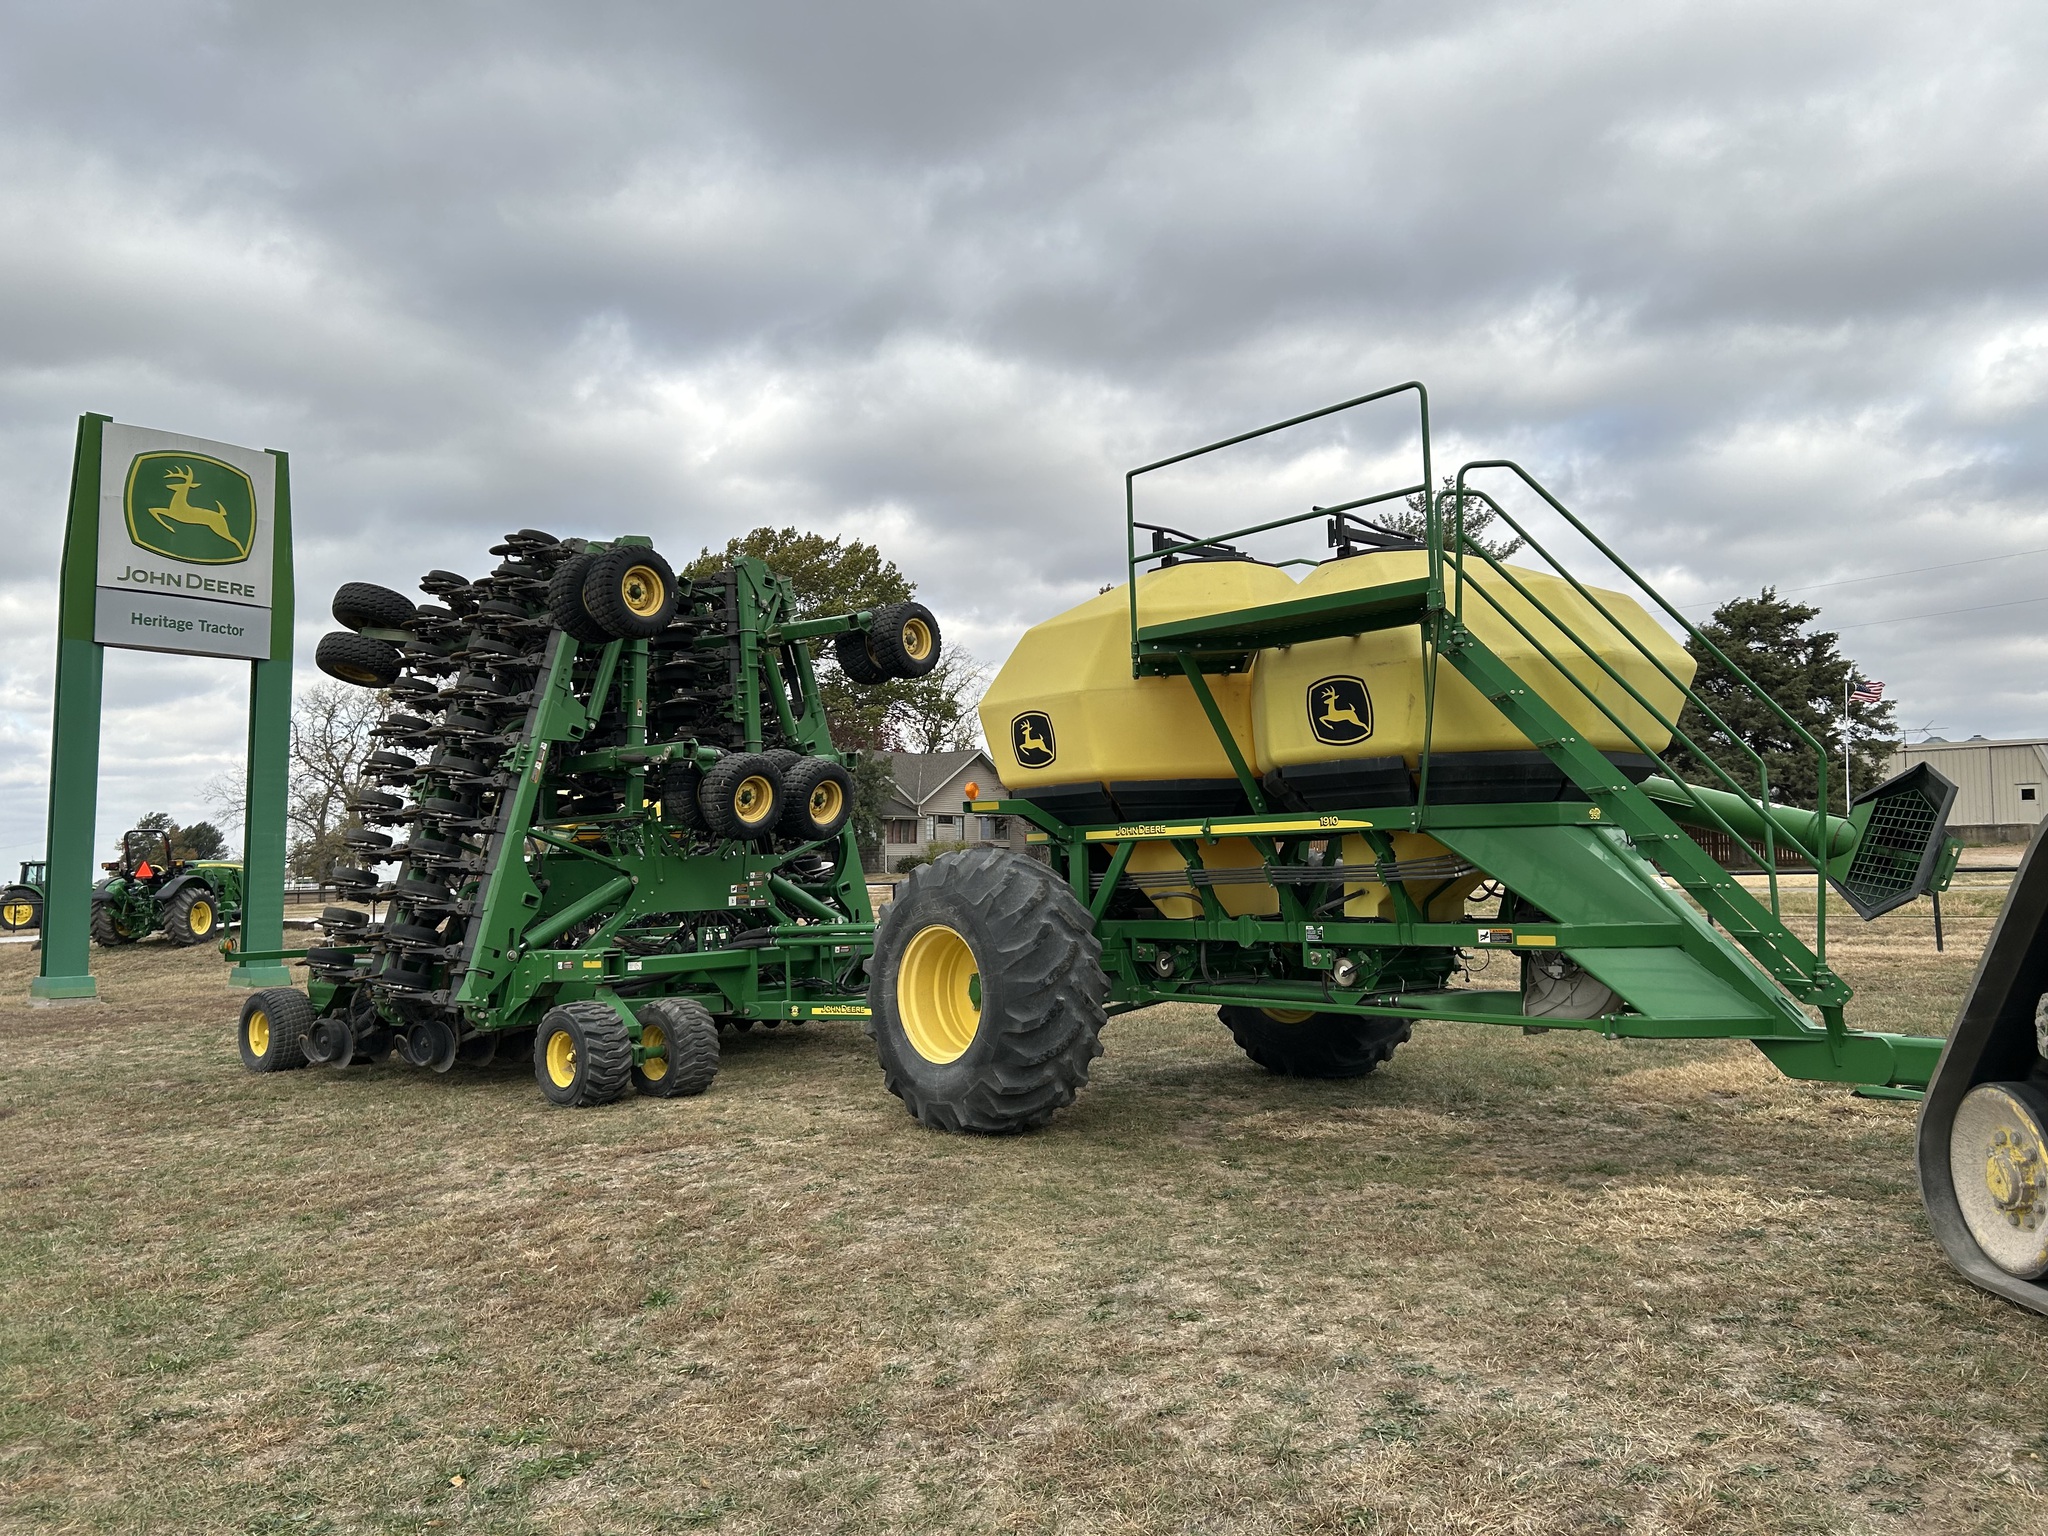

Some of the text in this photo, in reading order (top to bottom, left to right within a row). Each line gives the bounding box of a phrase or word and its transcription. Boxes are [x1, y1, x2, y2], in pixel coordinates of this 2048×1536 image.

[117, 566, 255, 598] JOHN DEERE
[131, 612, 245, 637] Heritage Tractor
[1319, 815, 1339, 827] 1910
[1115, 824, 1166, 836] JOHN DEERE
[821, 1004, 866, 1014] JOHN DEERE
